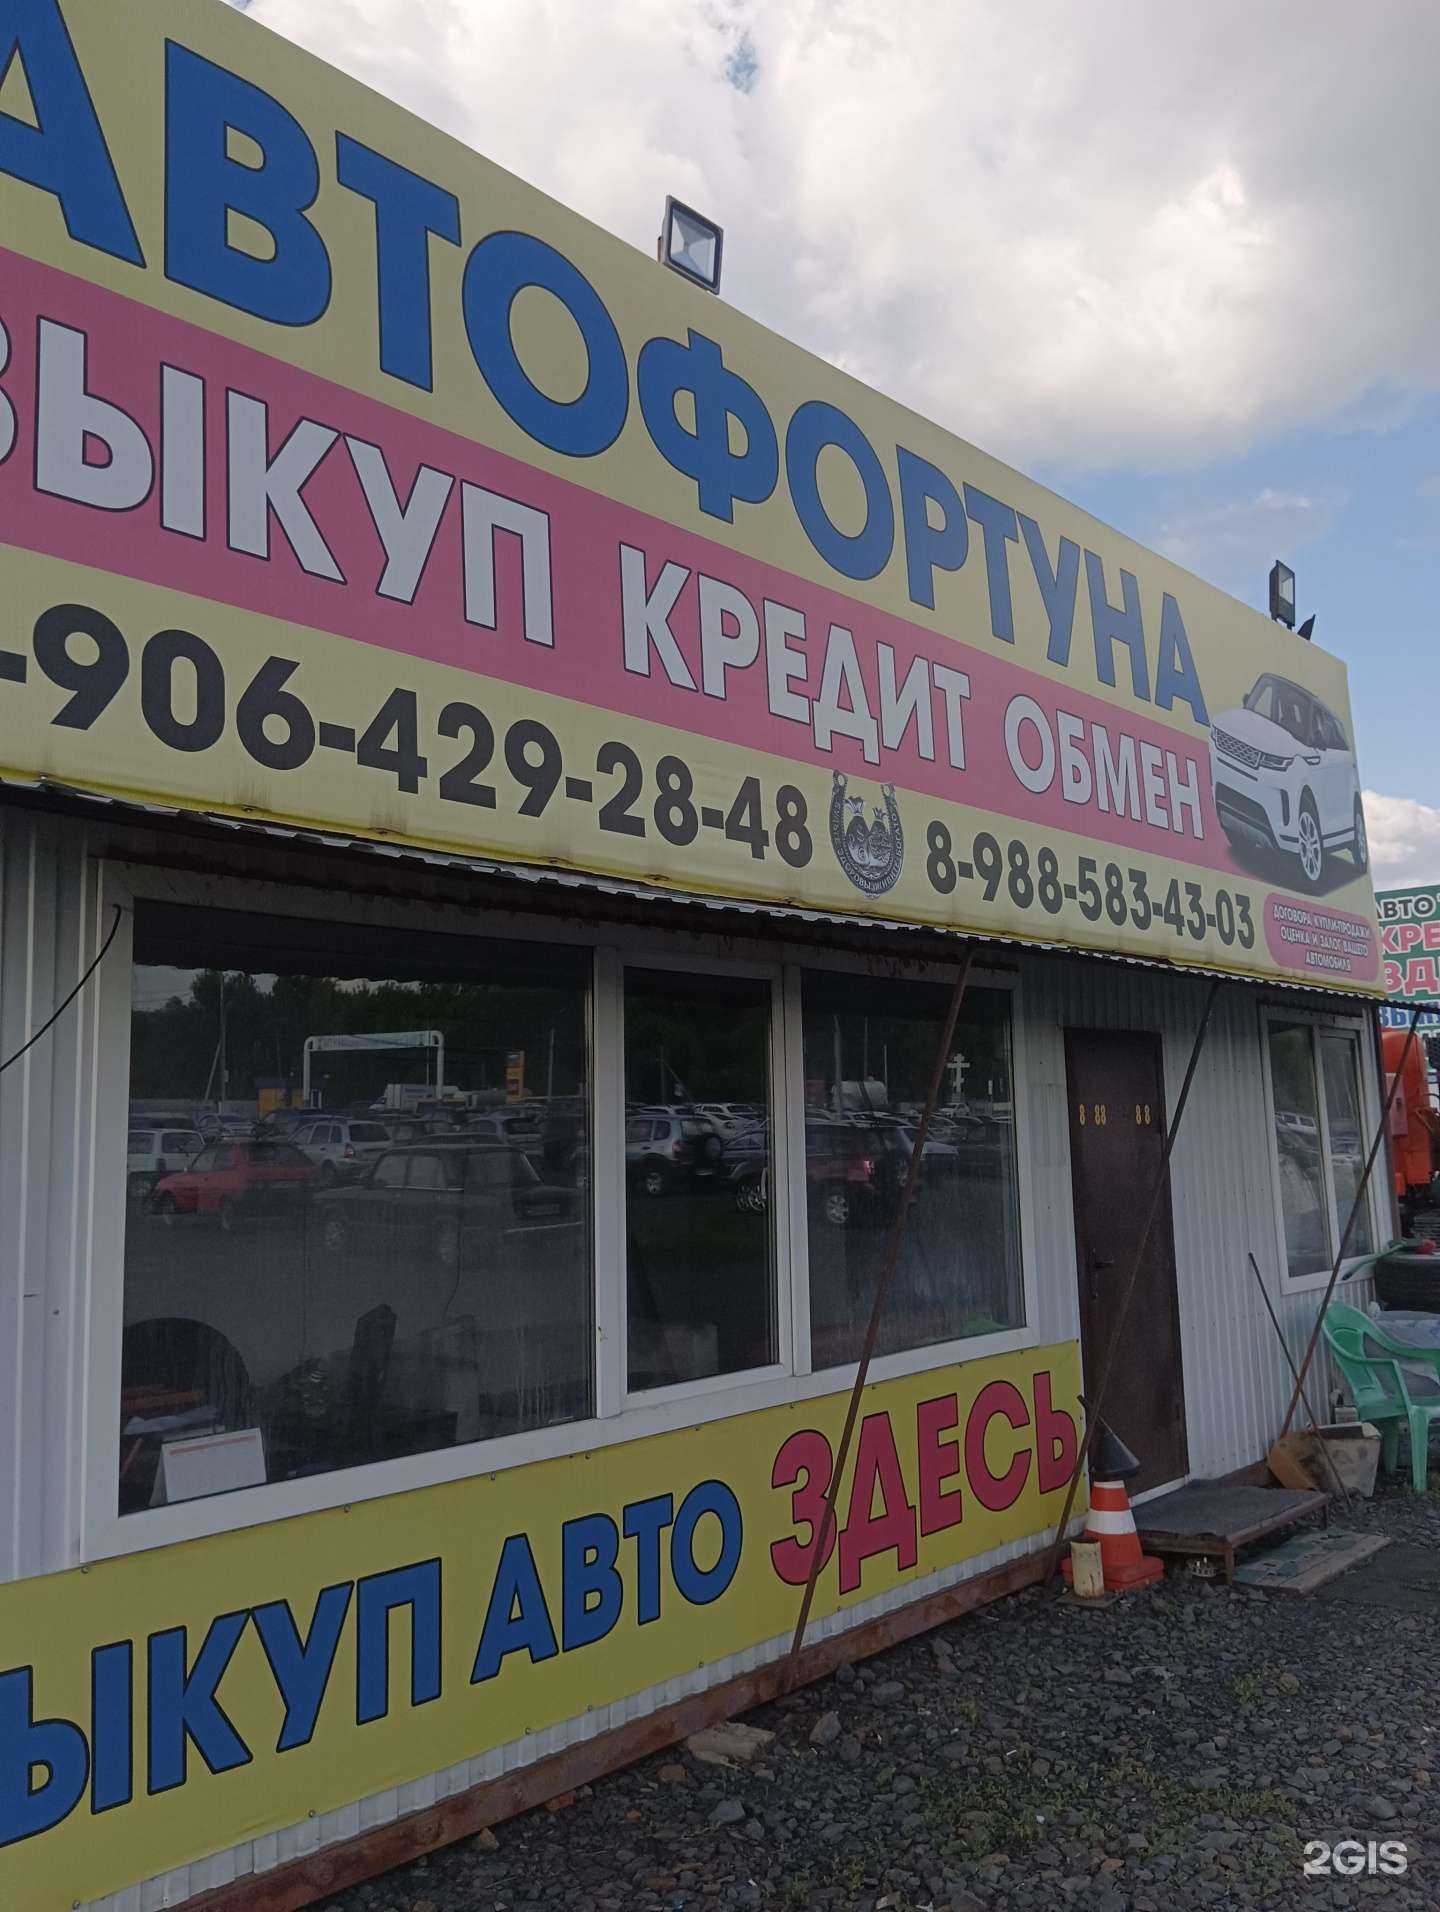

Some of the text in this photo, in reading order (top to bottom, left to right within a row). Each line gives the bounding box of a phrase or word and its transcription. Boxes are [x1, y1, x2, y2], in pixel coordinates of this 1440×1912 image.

[0, 314, 1204, 840] ЫКУП КРЕДИТ ОБМЕН
[837, 848, 871, 890] ЗДОРОВЫ
[891, 813, 902, 856] БОГАТО
[926, 820, 1256, 950] 8-988-583-43-03
[1377, 894, 1436, 921] ВТО
[1273, 903, 1370, 939] ДОГОВОРА КУПЛИ-ПРОДАЖИ
[1281, 926, 1368, 957] ОЦЕНКА И ЗАЛОГ ВАШЕГО
[1305, 950, 1351, 972] АВТОМОБИЛЯ
[470, 1480, 743, 1686] АВТО
[770, 1372, 1079, 1596] ЗДЕСЬ
